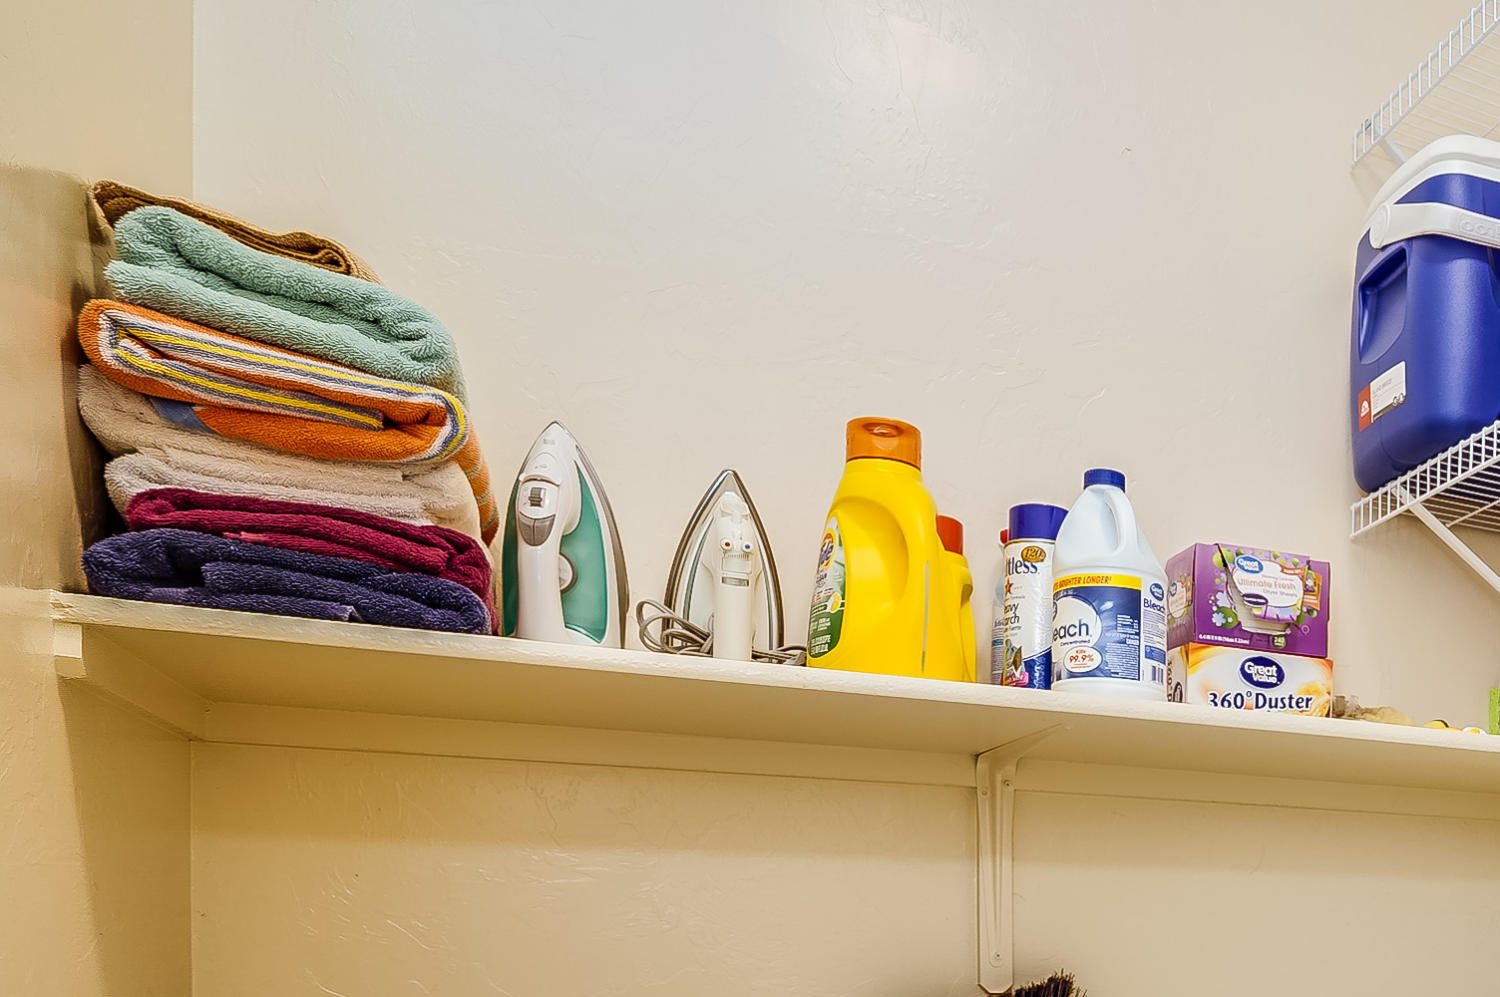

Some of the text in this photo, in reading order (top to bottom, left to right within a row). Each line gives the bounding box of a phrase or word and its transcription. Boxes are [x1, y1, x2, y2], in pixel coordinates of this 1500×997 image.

[1083, 575, 1112, 585] LONGER!
[1237, 577, 1272, 588] Ultimate
[1274, 580, 1296, 590] Fresh
[1144, 598, 1165, 614] Bleac
[1069, 654, 1095, 664] 99.9%
[1244, 661, 1278, 677] Great
[1253, 670, 1279, 684] Value
[1254, 692, 1313, 709] Duster
